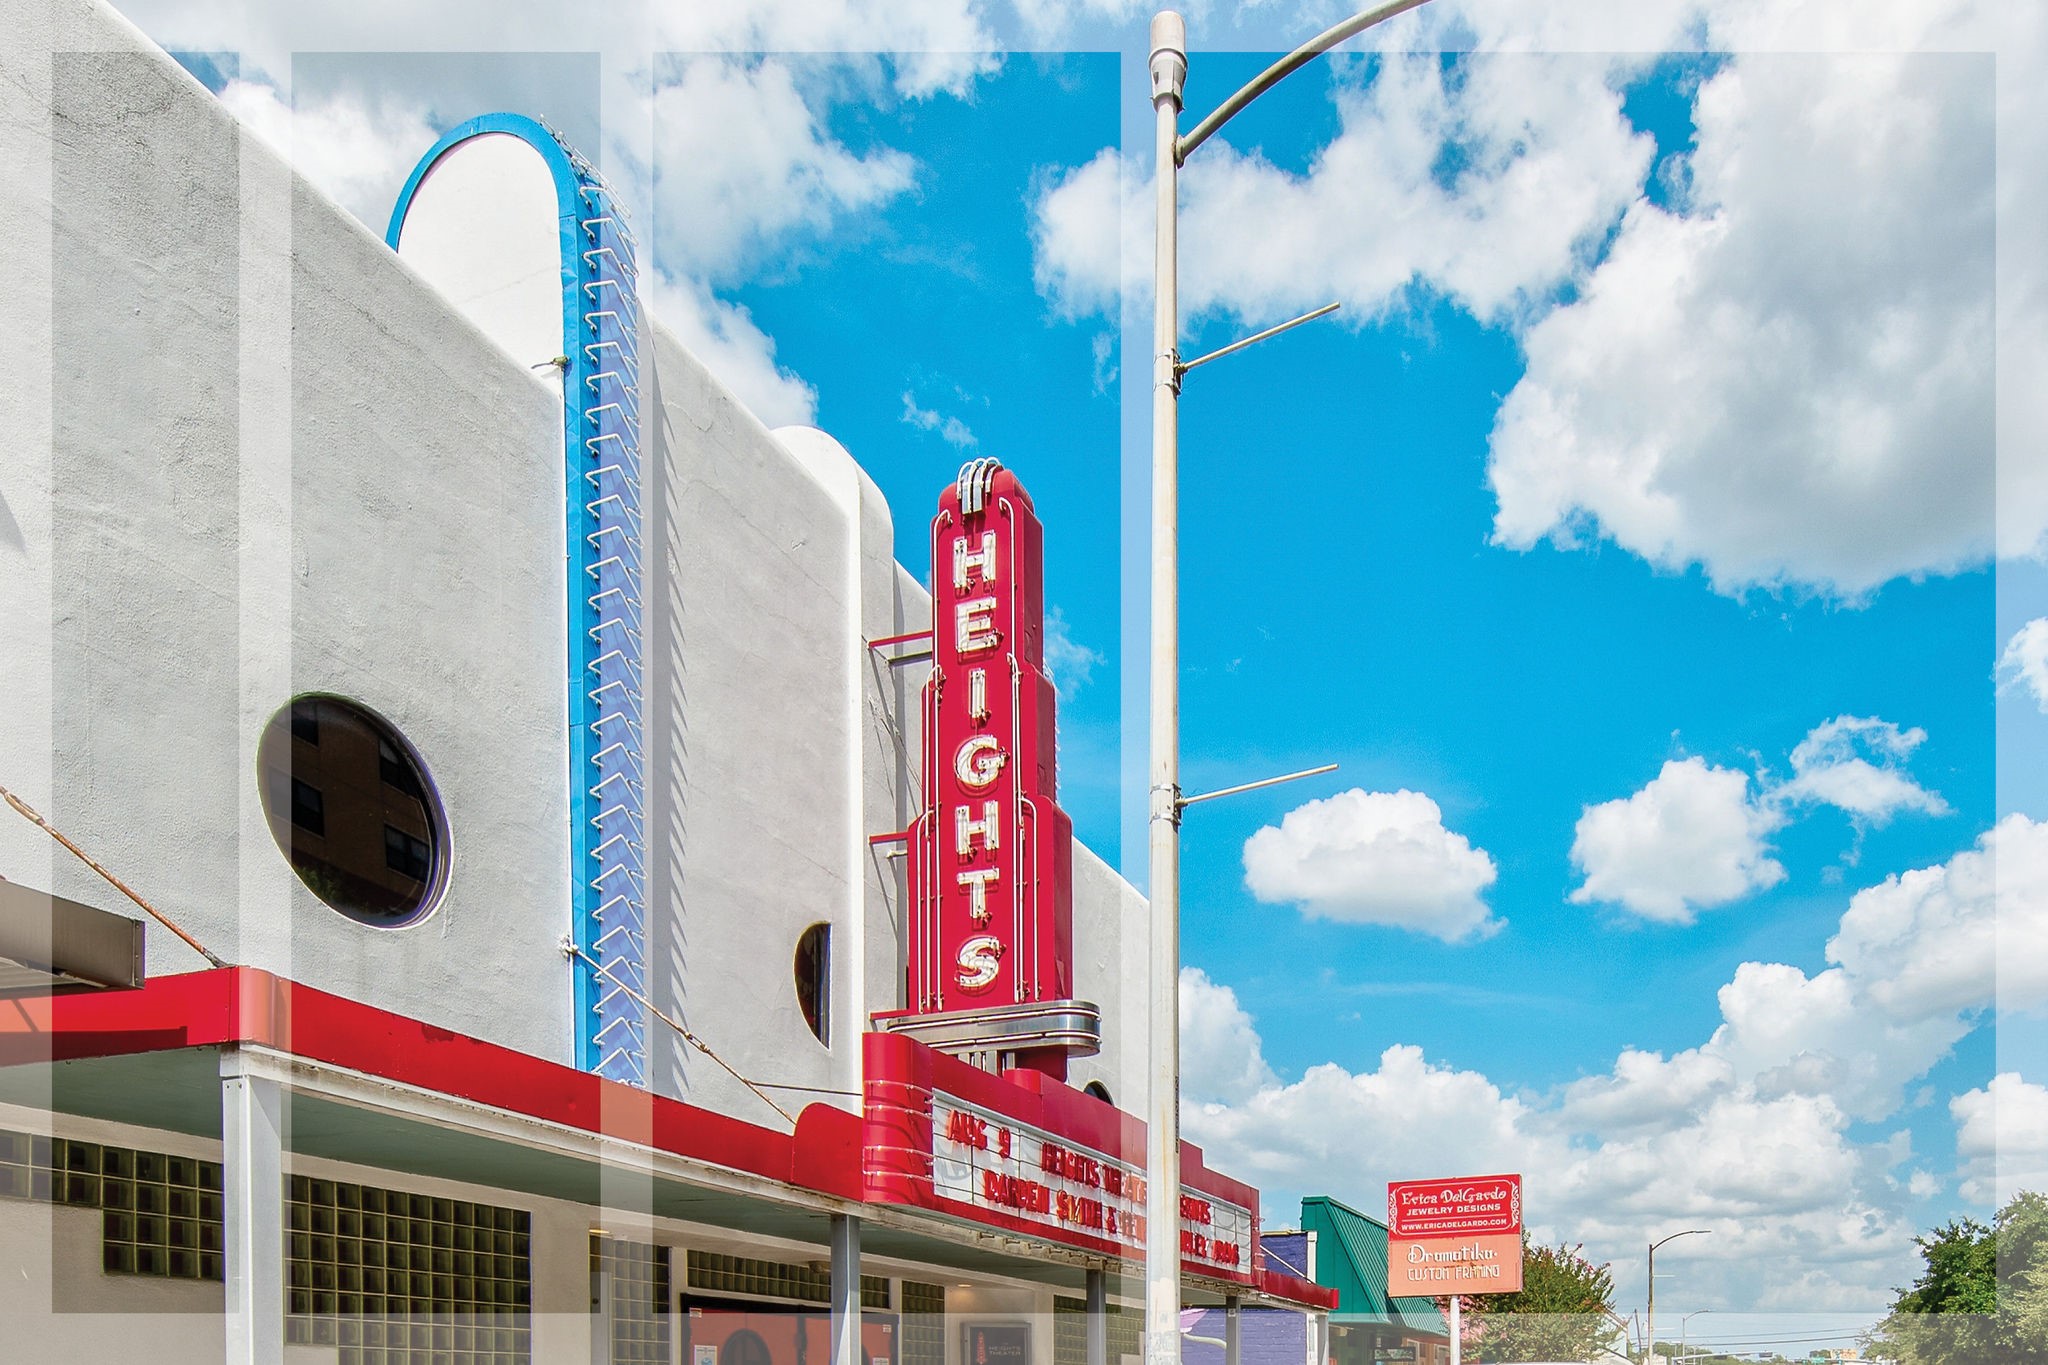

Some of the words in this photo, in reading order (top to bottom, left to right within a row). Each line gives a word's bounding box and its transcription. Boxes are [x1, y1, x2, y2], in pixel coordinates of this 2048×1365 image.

[953, 529, 1003, 991] HEIGHTS
[998, 1127, 1011, 1158] 9
[1041, 1140, 1100, 1189] HEIGHTS
[1101, 1163, 1147, 1206] THEATE
[1401, 1191, 1438, 1206] Erica
[1406, 1206, 1454, 1216] JEWELRY
[1457, 1203, 1501, 1213] DESIGNS
[1401, 1218, 1507, 1231] WWW.ERICADELGARDO.COM
[1407, 1266, 1450, 1282] CUSTOM
[1455, 1264, 1500, 1280] FRAMING
